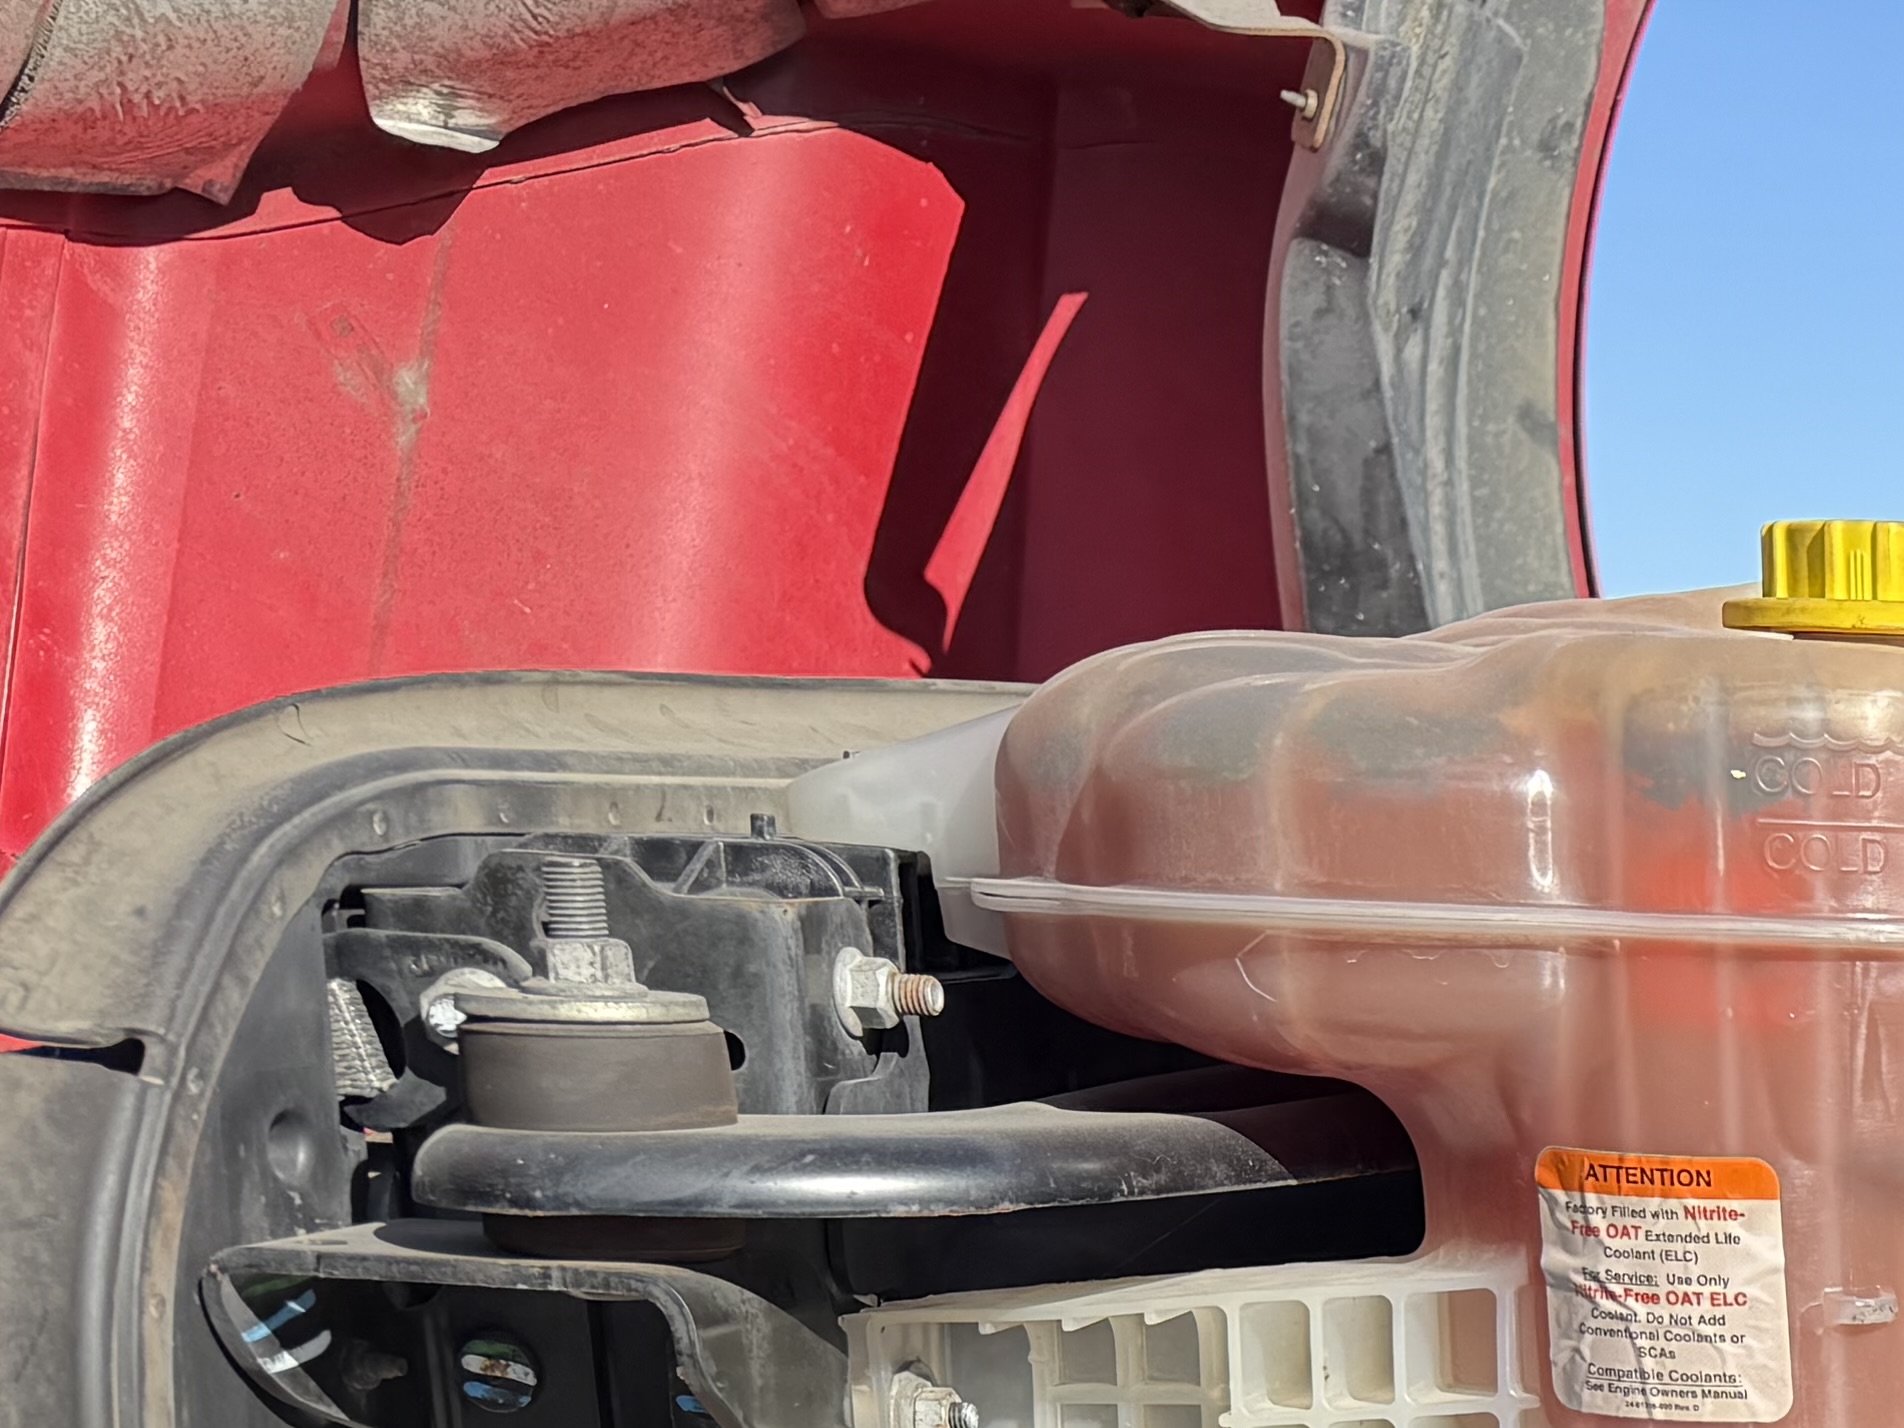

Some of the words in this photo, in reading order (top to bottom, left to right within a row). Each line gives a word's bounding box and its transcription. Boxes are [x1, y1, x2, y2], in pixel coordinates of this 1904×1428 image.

[1753, 755, 1881, 799] COLD
[1764, 832, 1887, 873] COLD
[1585, 1163, 1712, 1187] ATTENTION
[1565, 1201, 1608, 1218] Factory
[1611, 1205, 1646, 1219] Filled
[1650, 1207, 1679, 1220] with
[1683, 1205, 1746, 1221] Nitrite-
[1570, 1220, 1600, 1238] Free
[1606, 1224, 1642, 1240] OAT
[1644, 1230, 1710, 1244] Extended
[1715, 1232, 1741, 1245] Life
[1603, 1246, 1656, 1262] Coolant
[1660, 1249, 1699, 1265] (ELC)
[1604, 1270, 1659, 1285] Service:
[1666, 1274, 1692, 1286] Use
[1697, 1275, 1730, 1289] Only
[1575, 1283, 1660, 1305] Nitrite-Free
[1666, 1291, 1705, 1306] OAT
[1710, 1292, 1748, 1307] ELC
[1591, 1307, 1640, 1324] Coolant.
[1646, 1313, 1664, 1325] Do
[1669, 1314, 1692, 1326] Not
[1697, 1314, 1726, 1326] Add
[1579, 1323, 1660, 1342] Conventional
[1663, 1331, 1726, 1344] Coolants
[1730, 1334, 1746, 1344] or
[1637, 1347, 1676, 1360] SCAs
[1587, 1362, 1664, 1382] Compatible
[1668, 1371, 1742, 1384] Coolants:
[1584, 1381, 1604, 1392] See
[1608, 1383, 1647, 1398] Engine
[1650, 1387, 1698, 1399] Owners
[1701, 1388, 1748, 1400] Manual
